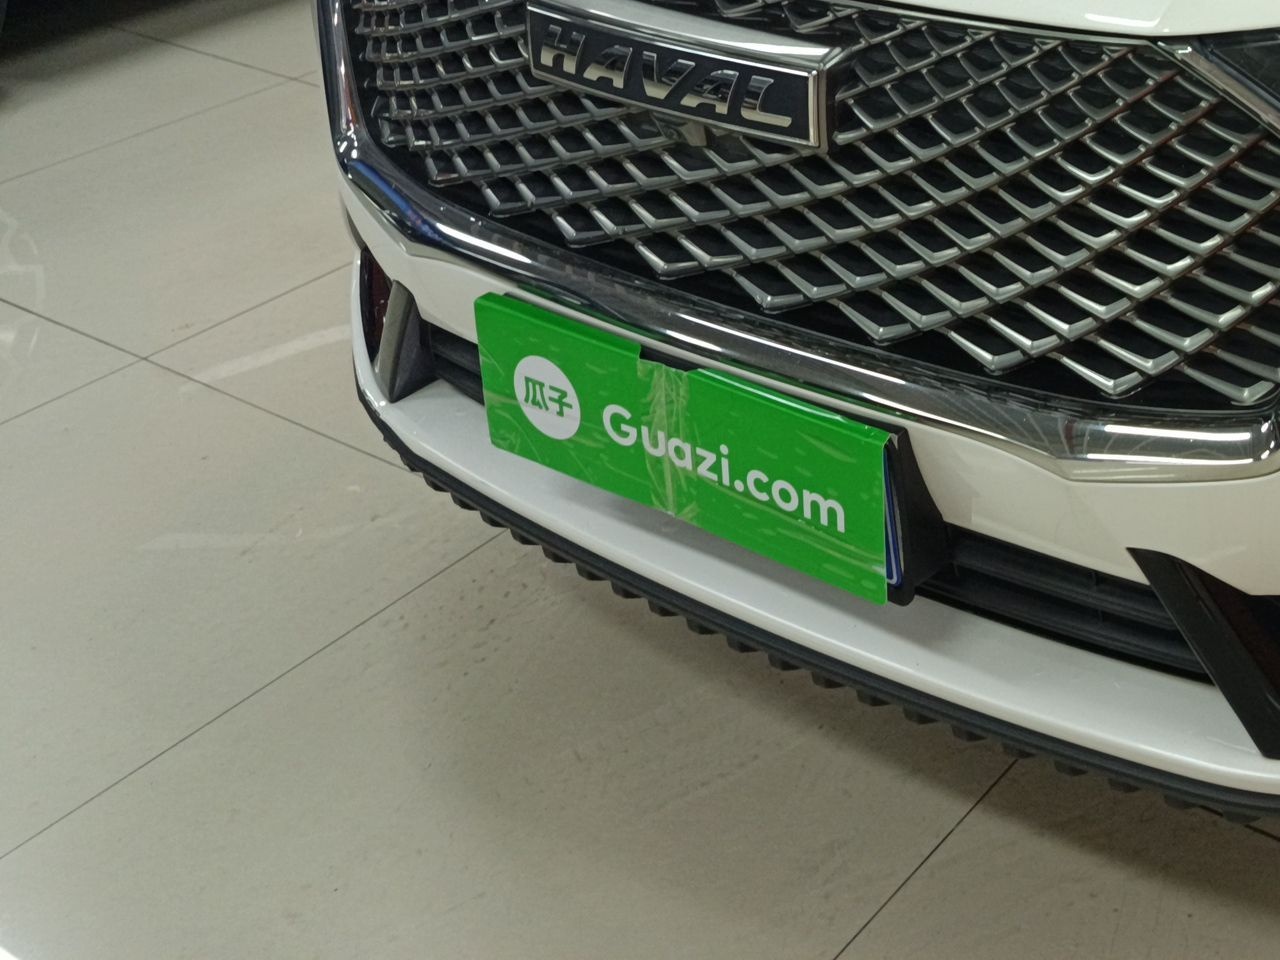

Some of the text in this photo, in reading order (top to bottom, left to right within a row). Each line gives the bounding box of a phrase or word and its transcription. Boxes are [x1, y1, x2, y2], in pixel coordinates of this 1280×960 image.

[540, 25, 793, 128] HAVAL
[523, 375, 574, 418] 瓜子
[602, 403, 846, 534] Guazi.com
